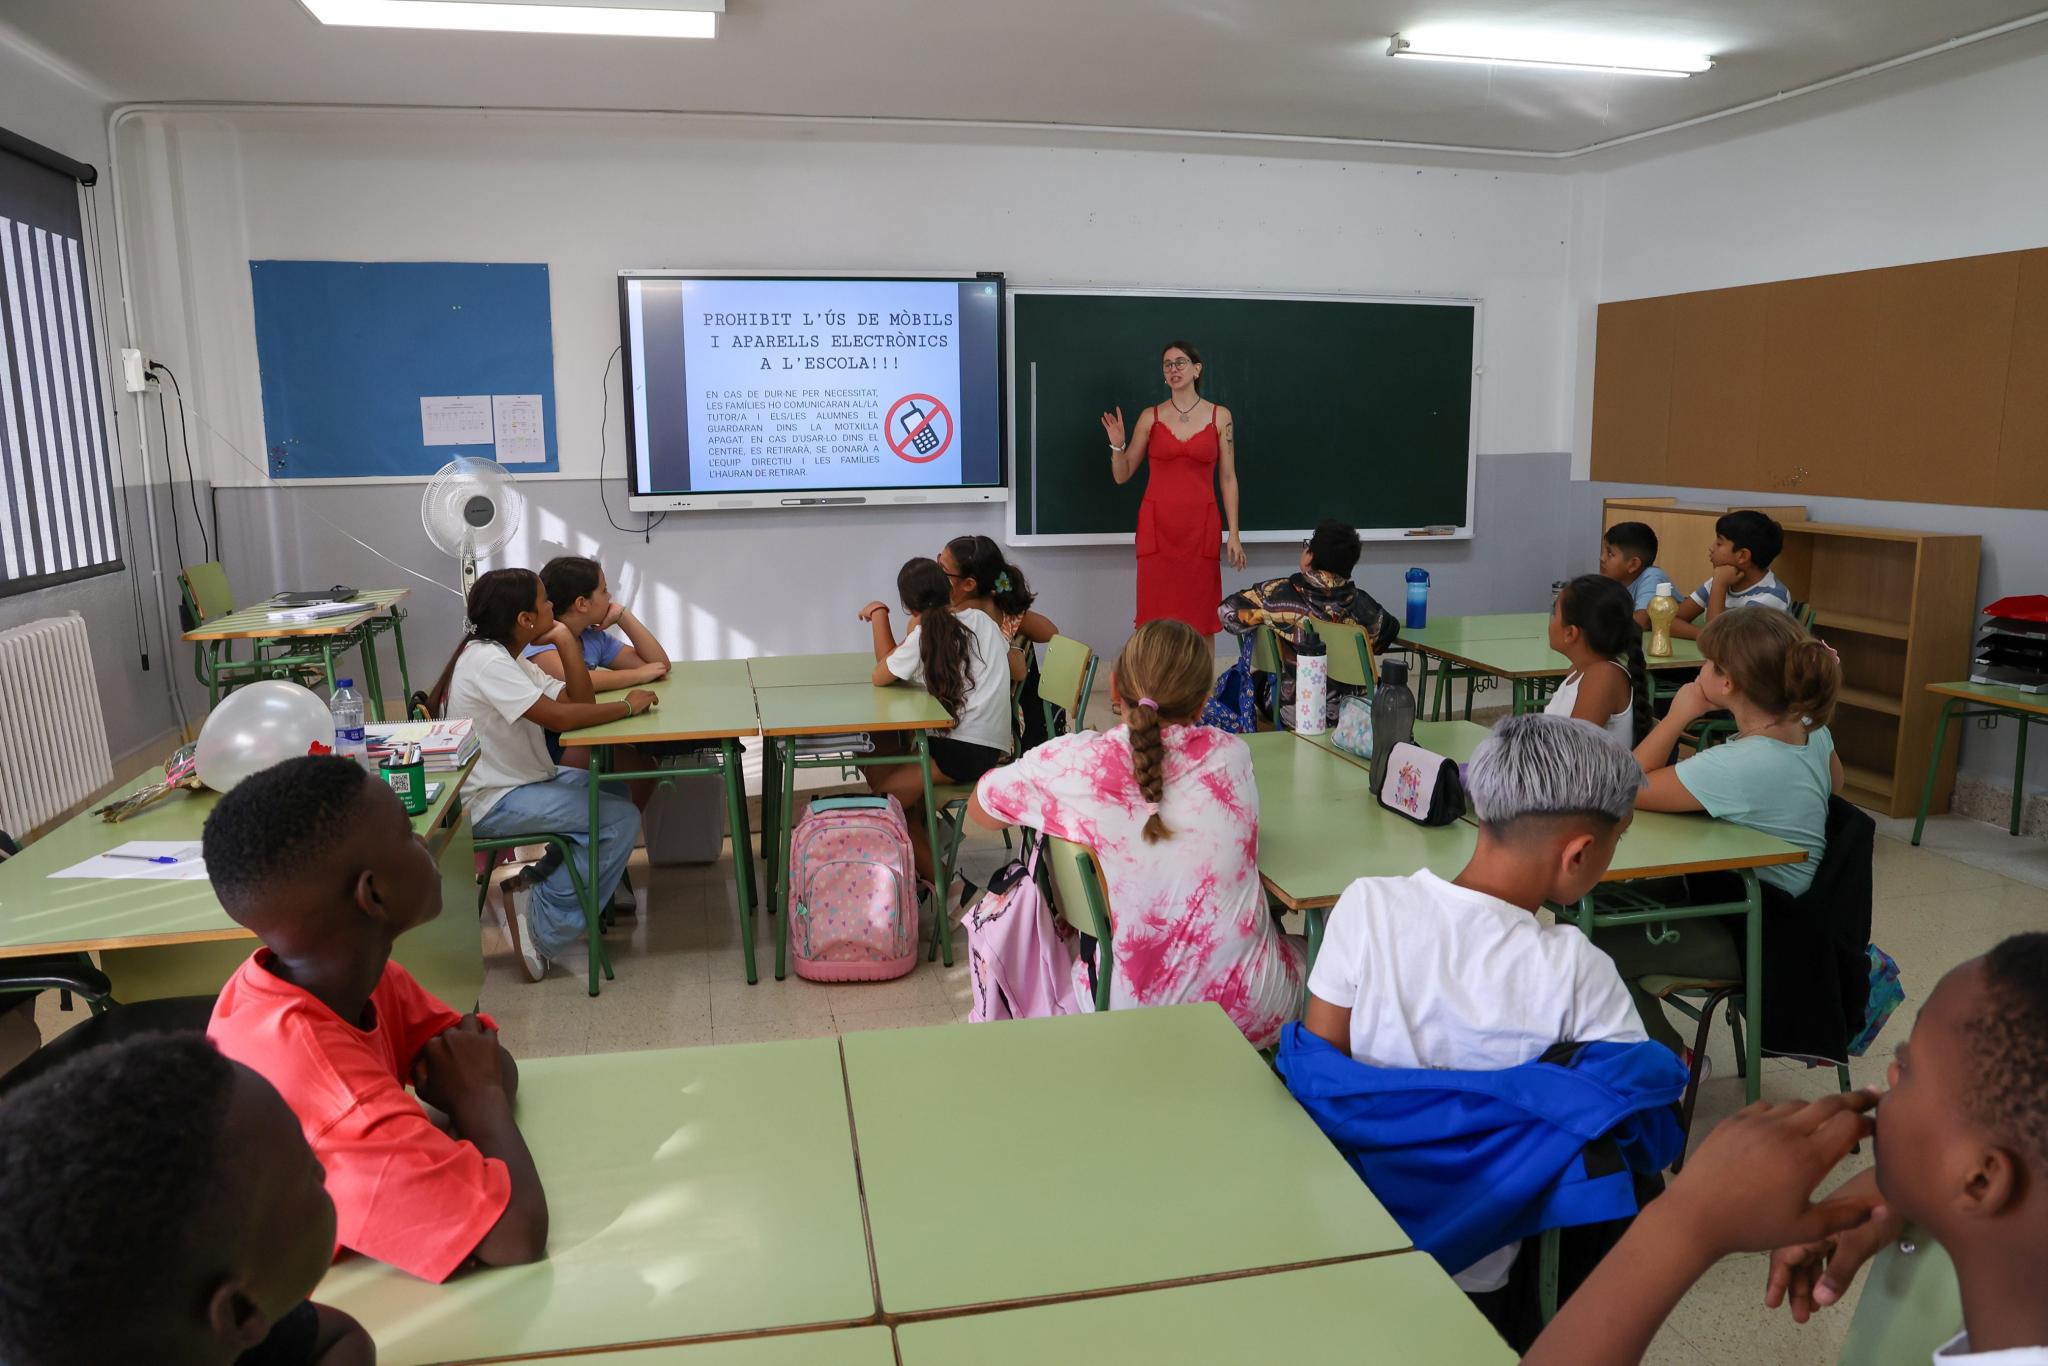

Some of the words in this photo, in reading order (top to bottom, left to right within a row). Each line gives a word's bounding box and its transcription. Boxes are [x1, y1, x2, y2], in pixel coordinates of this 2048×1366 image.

[703, 313, 792, 326] PROHIBIT
[803, 309, 846, 326] L'ÚS
[857, 313, 879, 325] DE
[890, 309, 953, 325] MÒBILS
[711, 336, 720, 348] I
[732, 335, 819, 348] APARELLS
[832, 331, 948, 347] ELECTRÒNICS
[760, 357, 771, 370] A
[782, 357, 898, 370] L'ESCOLA!!!
[725, 400, 766, 409] FAMÍLIES
[784, 400, 850, 409] COMUNICARAN
[852, 400, 878, 408] AL/LA
[707, 413, 747, 421] TUTOR/A
[831, 444, 868, 453] DONARÀ
[752, 458, 792, 466] DIRECTIU
[840, 455, 880, 464] FAMÍLIES
